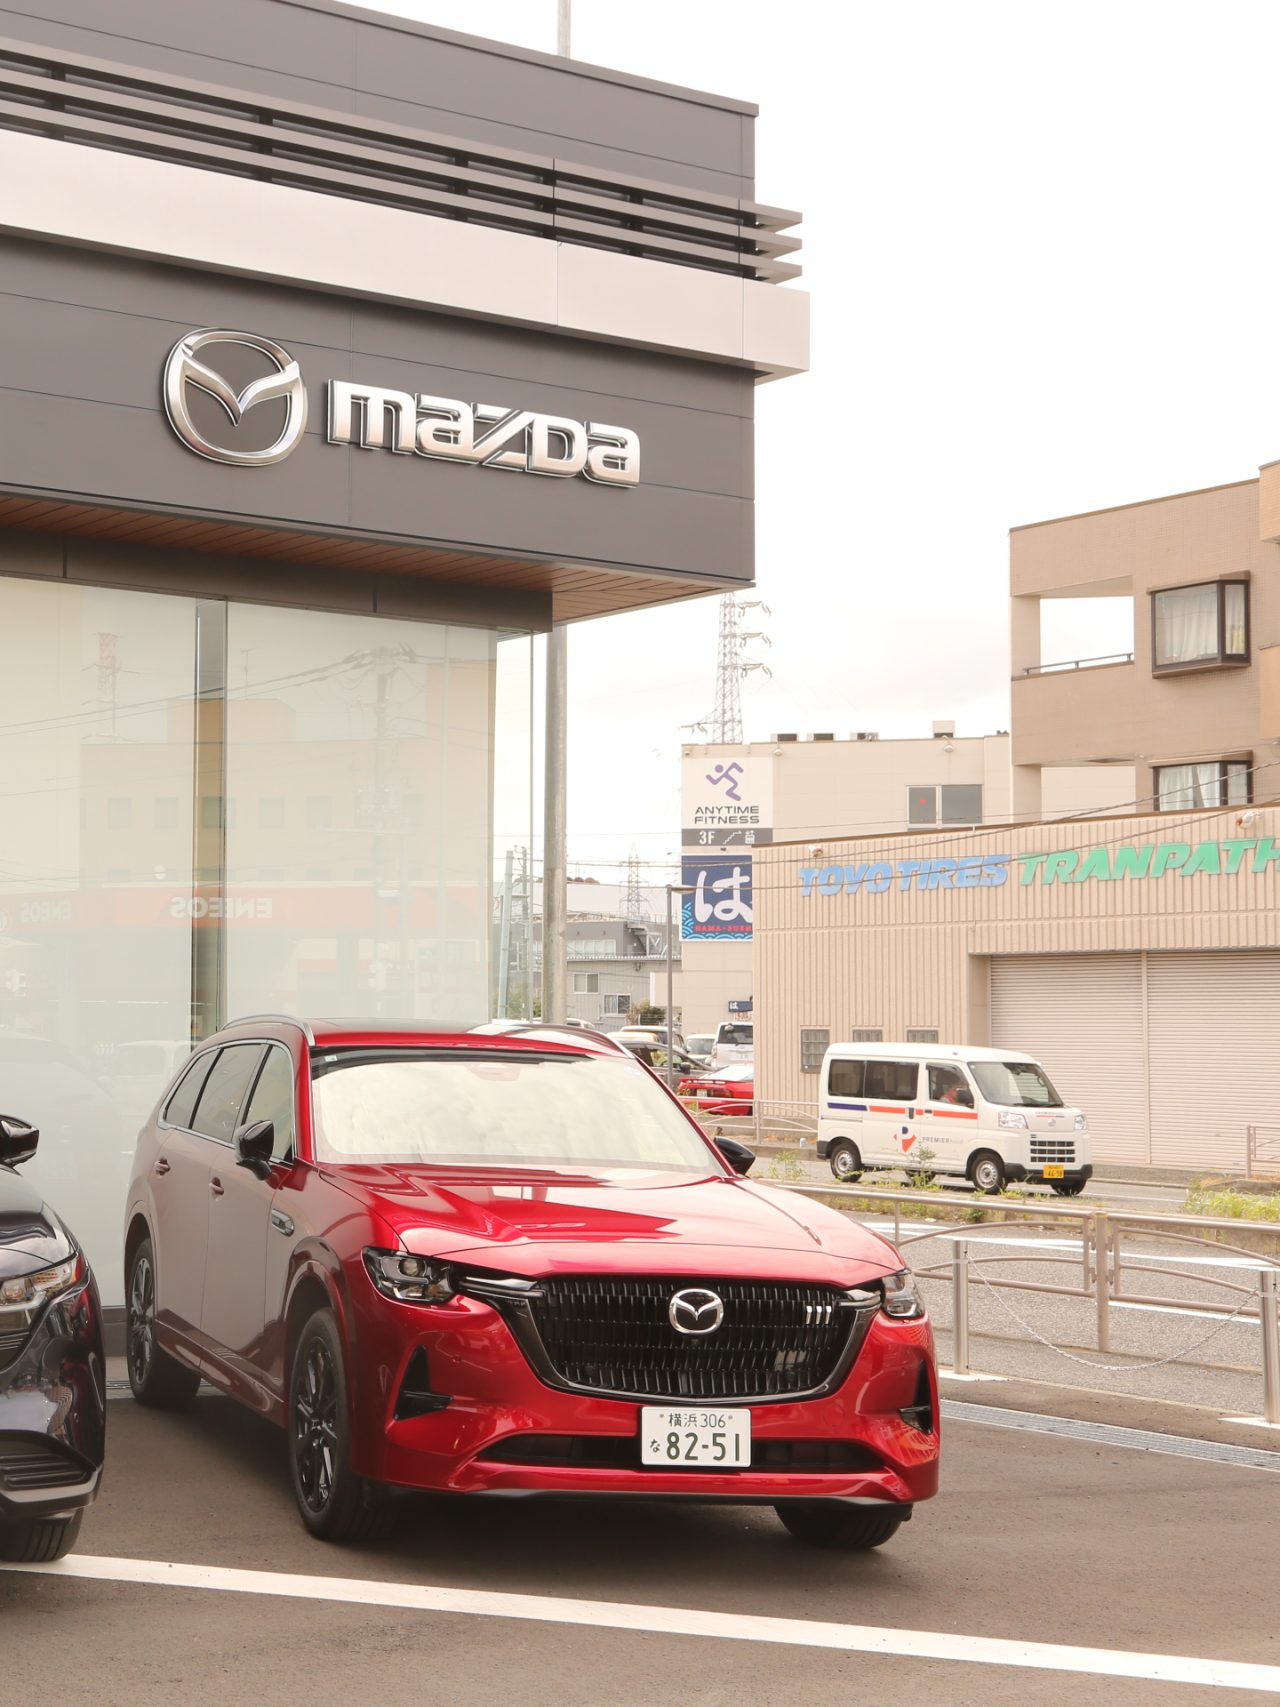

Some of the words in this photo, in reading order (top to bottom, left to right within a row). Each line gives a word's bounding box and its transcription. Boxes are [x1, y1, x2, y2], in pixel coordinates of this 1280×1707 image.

[695, 805, 759, 815] ANYTIME
[694, 815, 760, 825] FITNESS
[699, 831, 716, 845] 3F
[799, 863, 893, 897] TOYO
[895, 854, 1011, 891] TIRES
[695, 866, 753, 923] は
[694, 924, 753, 932] HAMA-SUSH
[666, 1431, 740, 1462] 82-51
